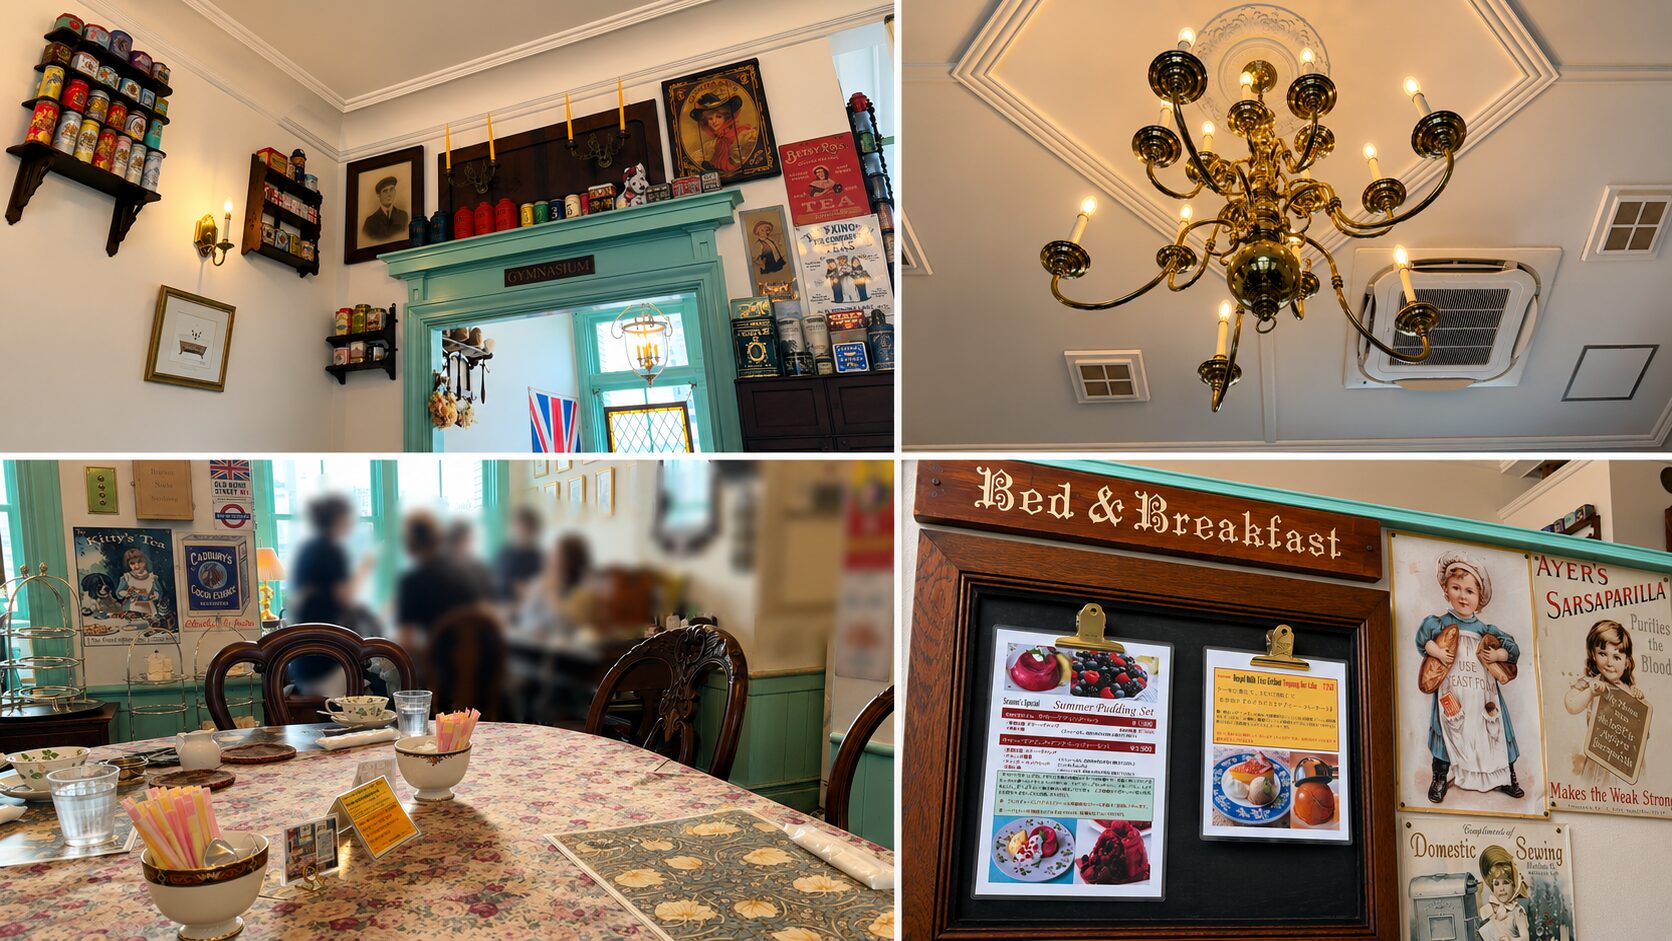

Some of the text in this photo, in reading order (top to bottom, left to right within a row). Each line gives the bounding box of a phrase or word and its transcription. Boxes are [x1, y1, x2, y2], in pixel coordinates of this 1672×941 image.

[801, 195, 855, 213] TEA
[507, 259, 590, 283] GYMNASIUM
[974, 466, 1342, 560] Bed & Breakfast
[86, 532, 166, 549] Kitty's Tea
[1536, 555, 1609, 586] AYER'S
[1546, 581, 1666, 619] SARSAPARILLA
[1648, 637, 1664, 652] the
[1459, 661, 1477, 673] USE
[1641, 655, 1672, 676] Blood
[1053, 700, 1095, 713] Summer
[1095, 702, 1137, 717] Pudding
[1138, 706, 1155, 716] Set
[1550, 782, 1587, 801] Makes
[1591, 786, 1607, 803] the
[1609, 787, 1639, 805] Weak
[1410, 832, 1563, 867] Domestic Sewing
